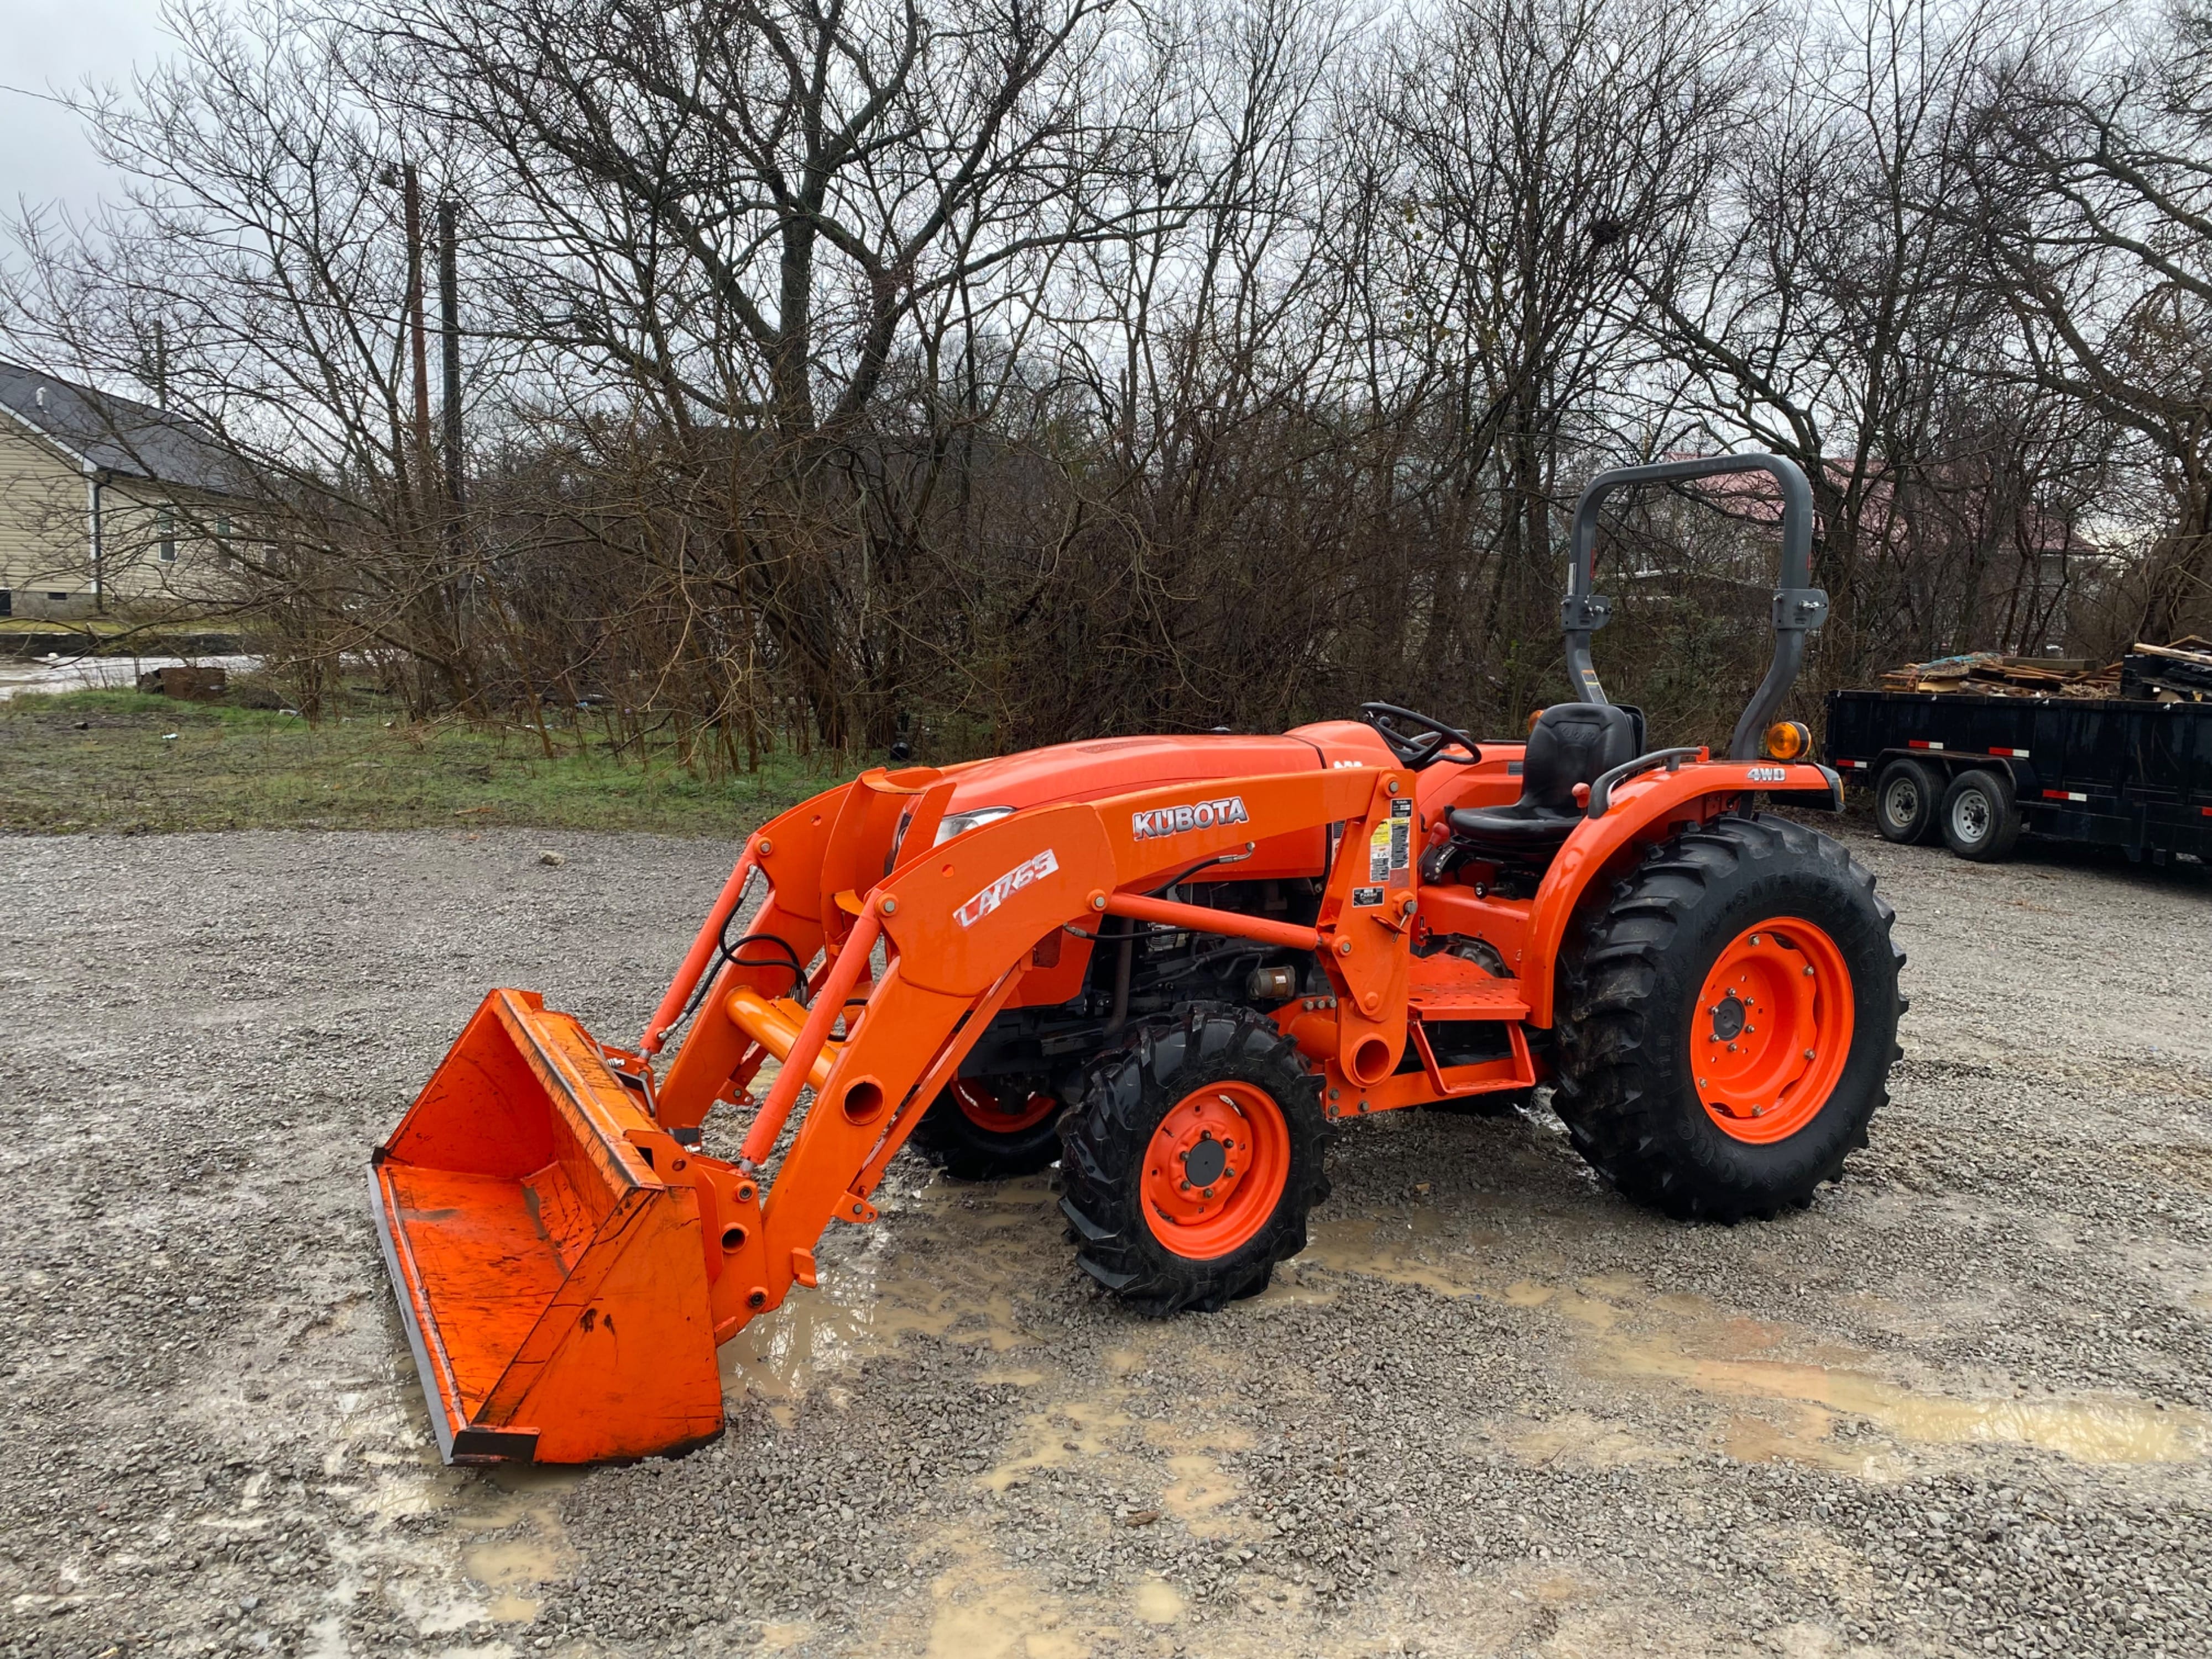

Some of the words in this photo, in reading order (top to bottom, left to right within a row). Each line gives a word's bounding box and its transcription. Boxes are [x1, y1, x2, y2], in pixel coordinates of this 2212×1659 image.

[1747, 768, 1786, 781] 4WD
[1134, 797, 1248, 840] KUBOTA
[956, 850, 1053, 928] LA765
